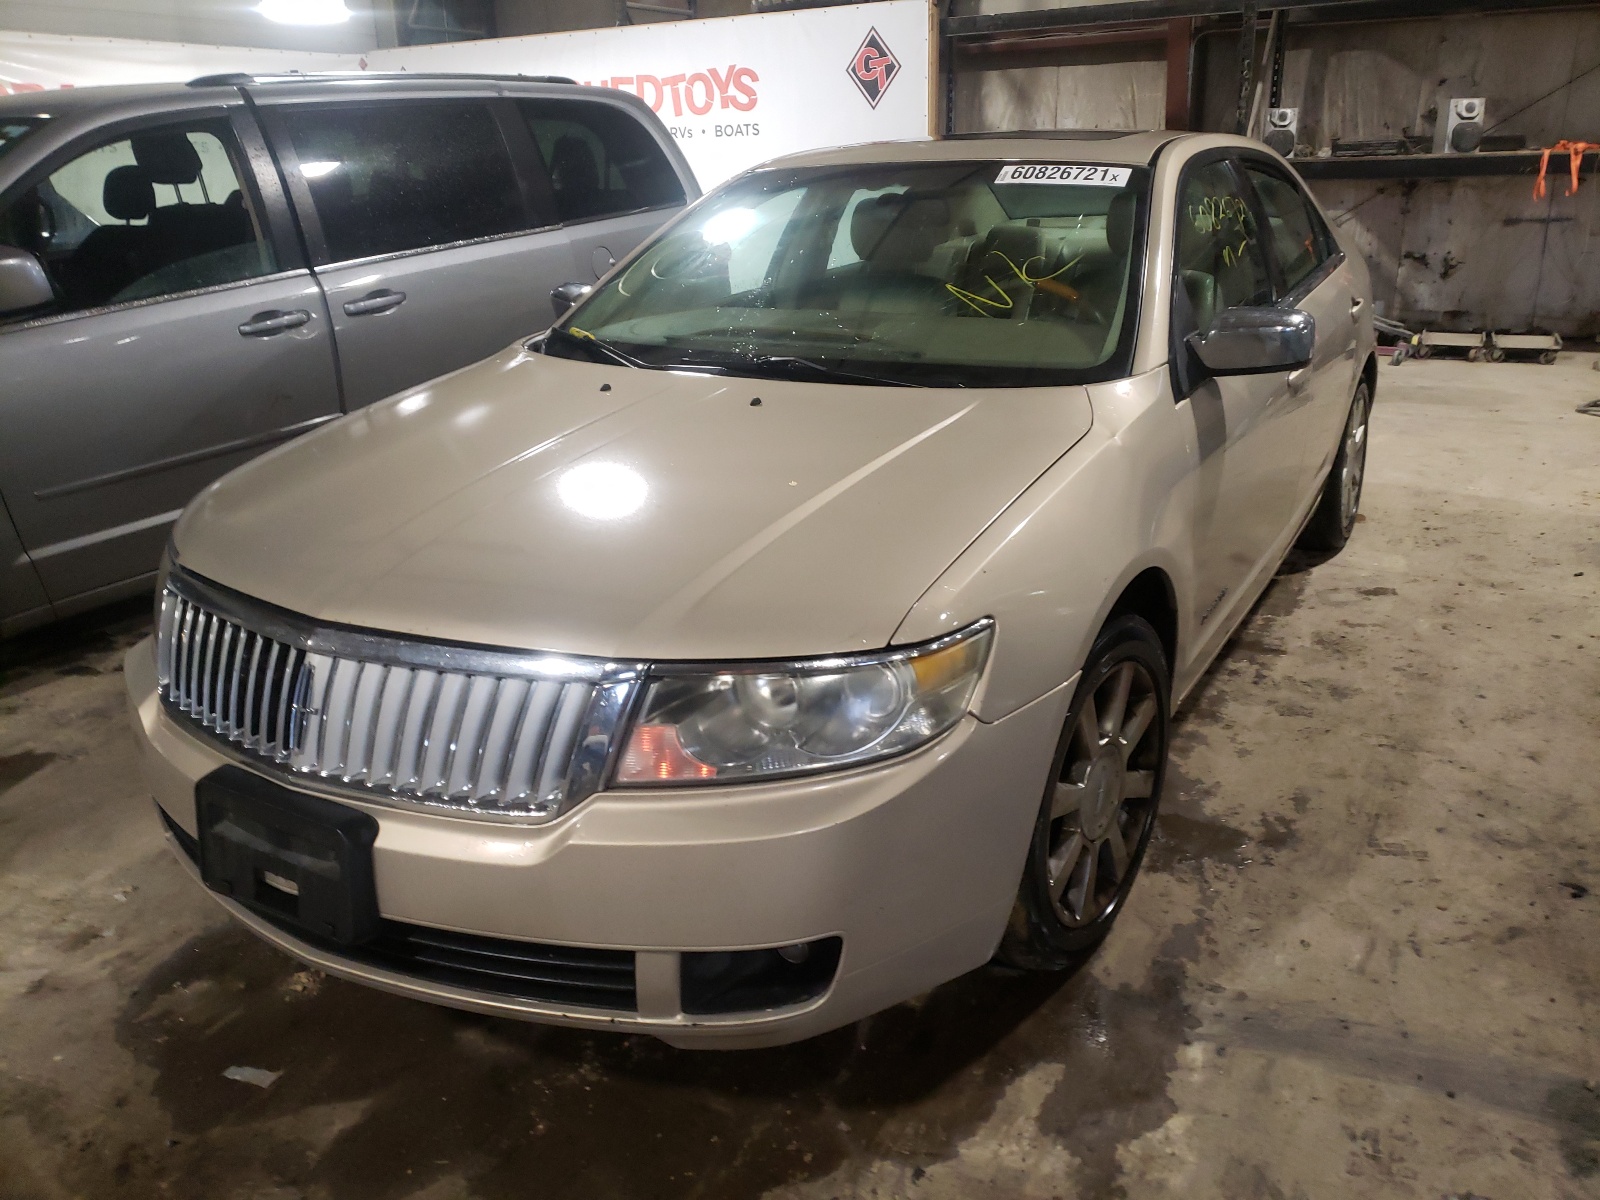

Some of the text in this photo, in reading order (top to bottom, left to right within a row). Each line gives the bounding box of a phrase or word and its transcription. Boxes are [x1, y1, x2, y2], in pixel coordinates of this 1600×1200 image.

[855, 46, 892, 91] GT
[670, 123, 760, 139] RVs BOATS
